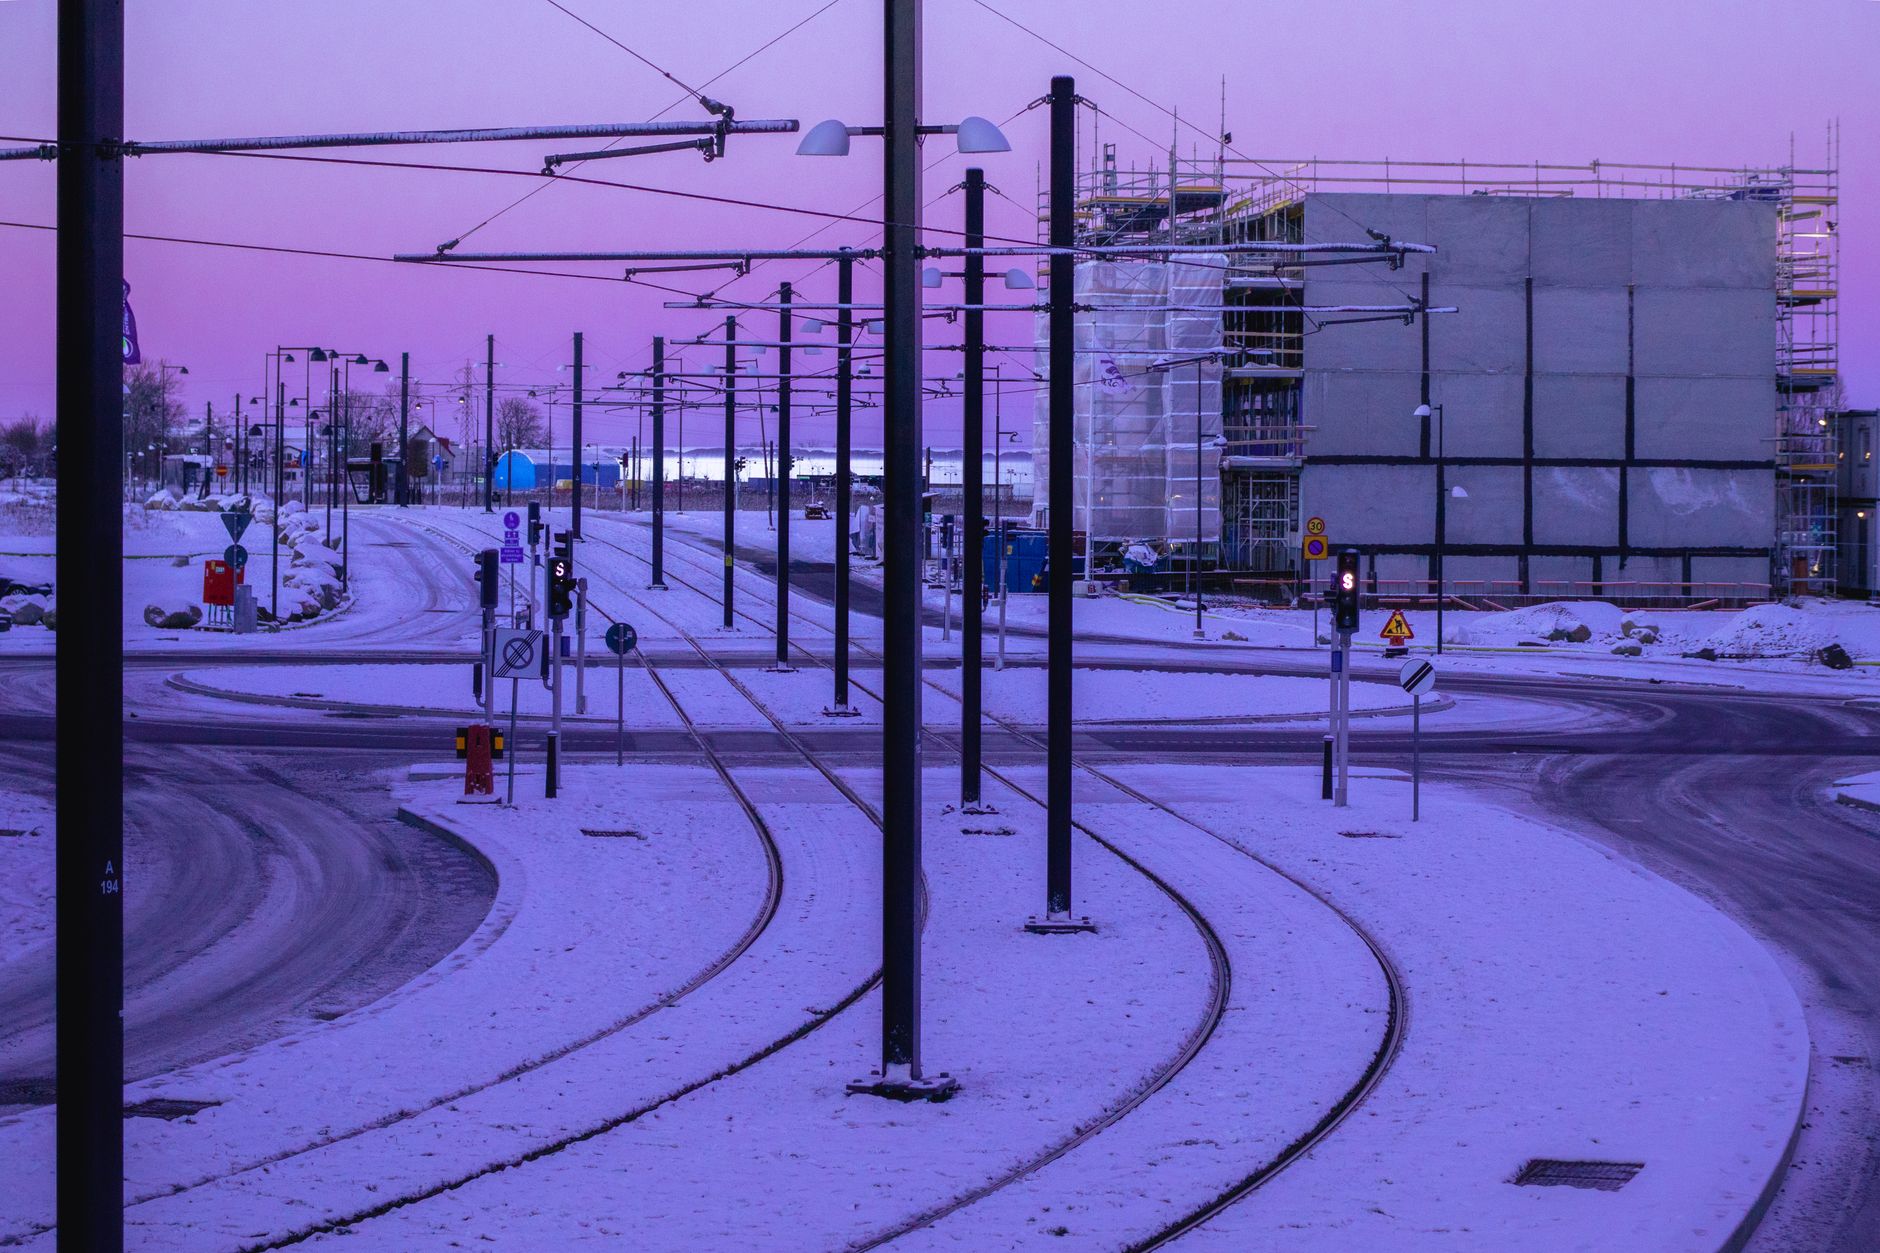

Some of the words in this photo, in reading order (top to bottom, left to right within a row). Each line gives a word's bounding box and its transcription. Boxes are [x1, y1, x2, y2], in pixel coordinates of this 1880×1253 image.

[1310, 521, 1322, 531] 30
[555, 562, 565, 577] S
[1342, 573, 1354, 590] S
[105, 860, 114, 875] A
[100, 879, 119, 895] 194
